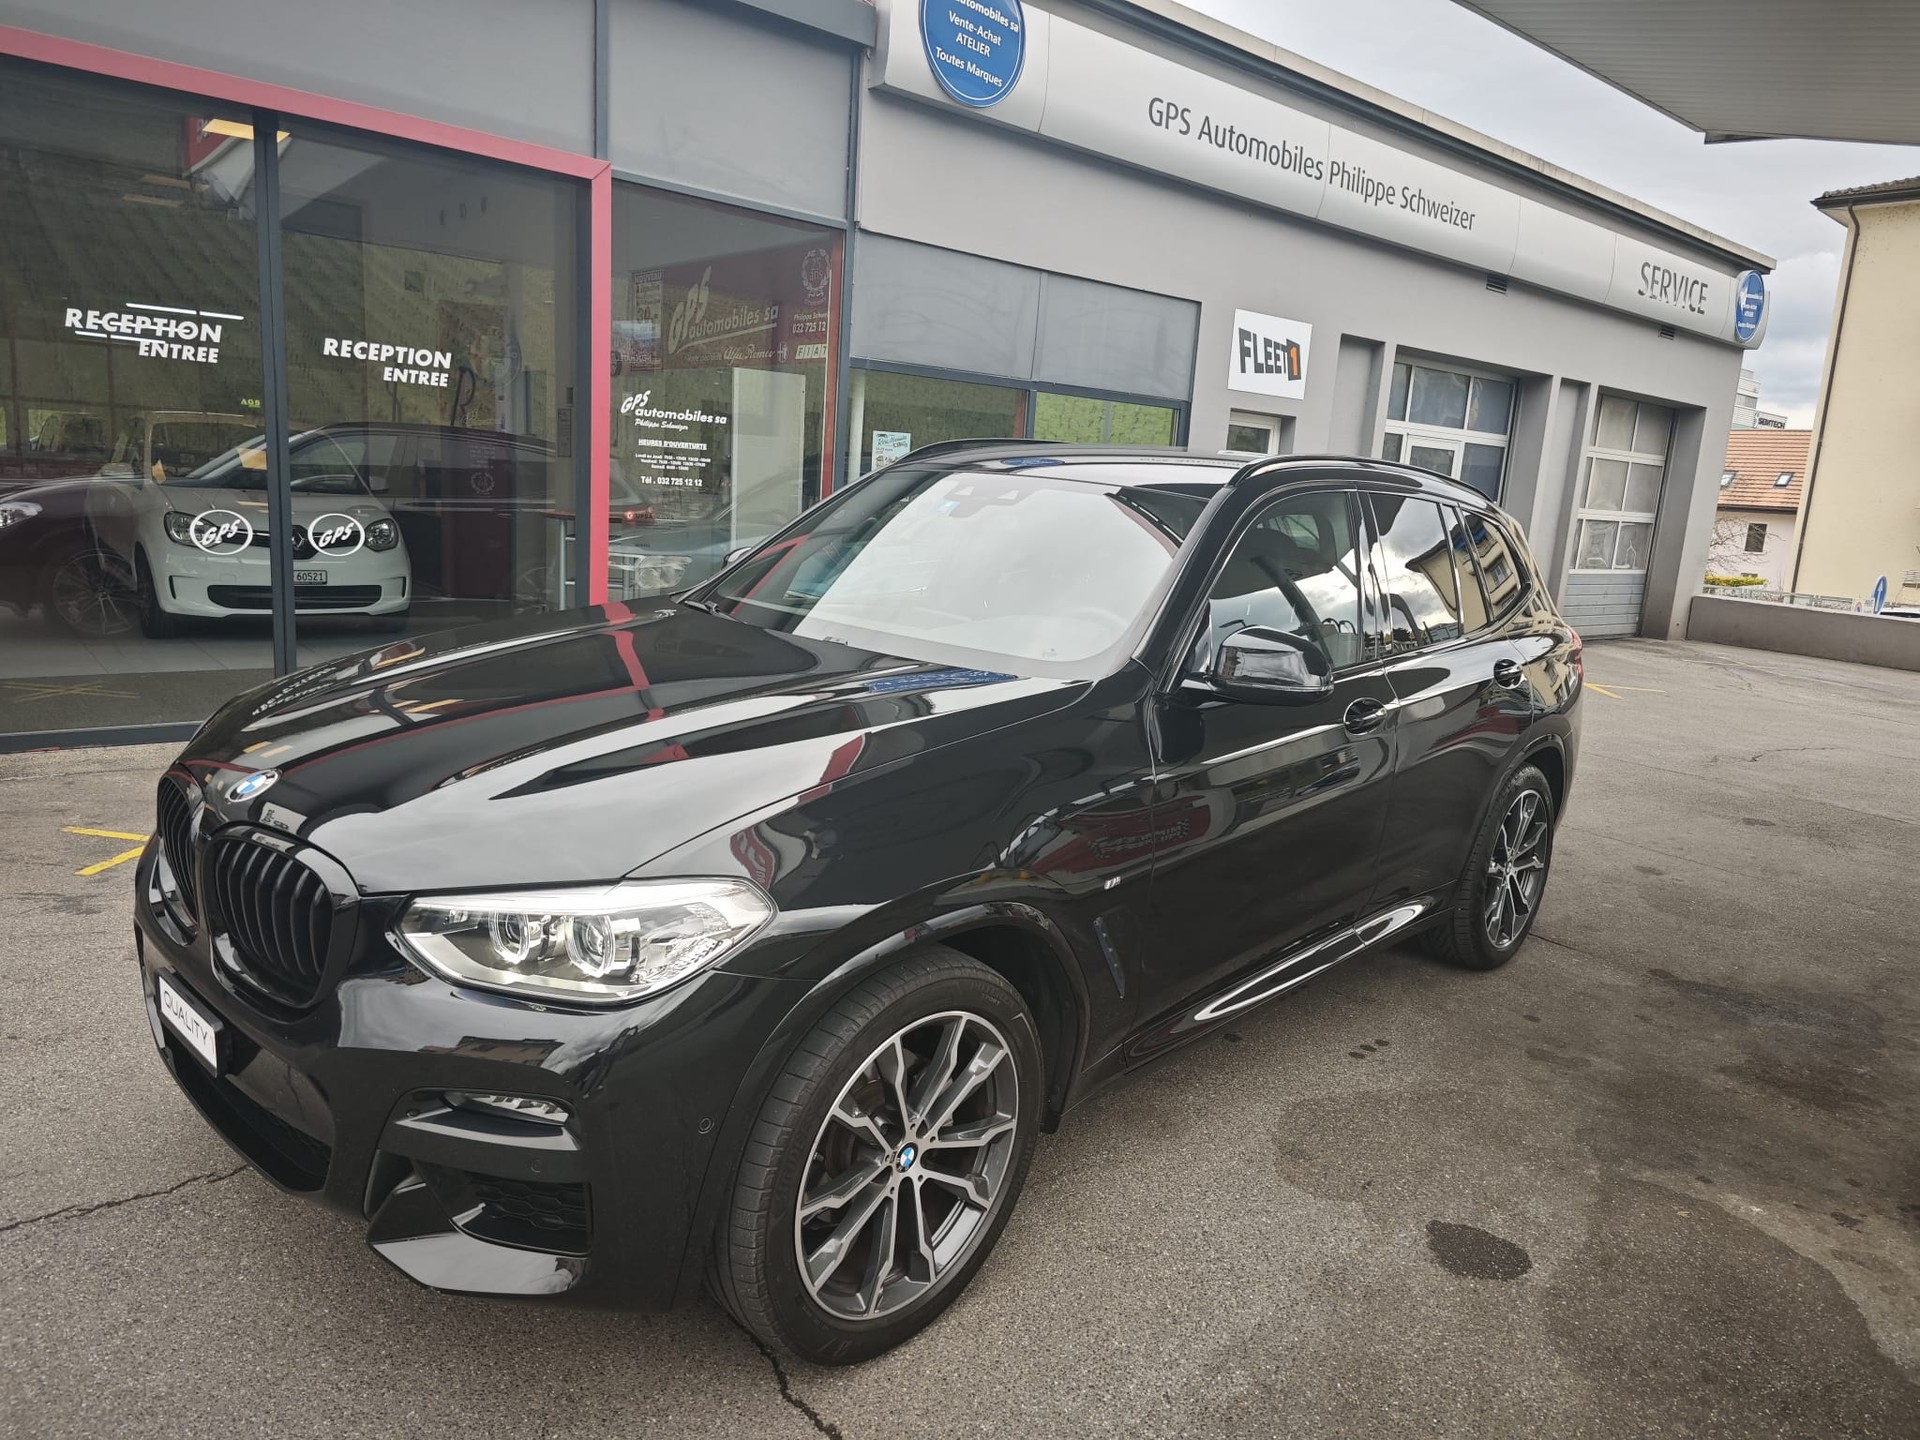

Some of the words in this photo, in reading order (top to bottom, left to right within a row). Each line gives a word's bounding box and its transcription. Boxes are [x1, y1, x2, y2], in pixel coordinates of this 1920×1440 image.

[948, 10, 1001, 46] Vente-Achat
[954, 0, 1009, 28] utomobiles
[1009, 19, 1019, 33] sa
[955, 32, 991, 58] ATELIER
[935, 46, 965, 70] Toutes
[966, 60, 1003, 88] Marques
[1148, 97, 1191, 136] GPS
[1197, 115, 1324, 181] Automobiles
[1329, 160, 1396, 207] Philippe
[1400, 186, 1476, 231] Schweizer
[1637, 261, 1709, 316] SERVICE
[64, 307, 223, 343] RECEPTION
[688, 305, 760, 339] automobiles
[763, 304, 779, 321] sa
[138, 340, 220, 364] ENTREE
[323, 337, 452, 369] RECEPTION
[383, 366, 449, 388] ENTREE
[620, 390, 651, 414] GPS
[634, 408, 713, 423] automobiles
[714, 415, 727, 424] sa
[657, 477, 670, 485] 032
[670, 477, 684, 486] 725
[684, 478, 693, 486] 12
[694, 479, 703, 487] 12
[201, 519, 241, 546] GPS
[318, 522, 354, 548] GPS
[296, 572, 323, 581] 60521
[163, 990, 208, 1046] QUALITY
